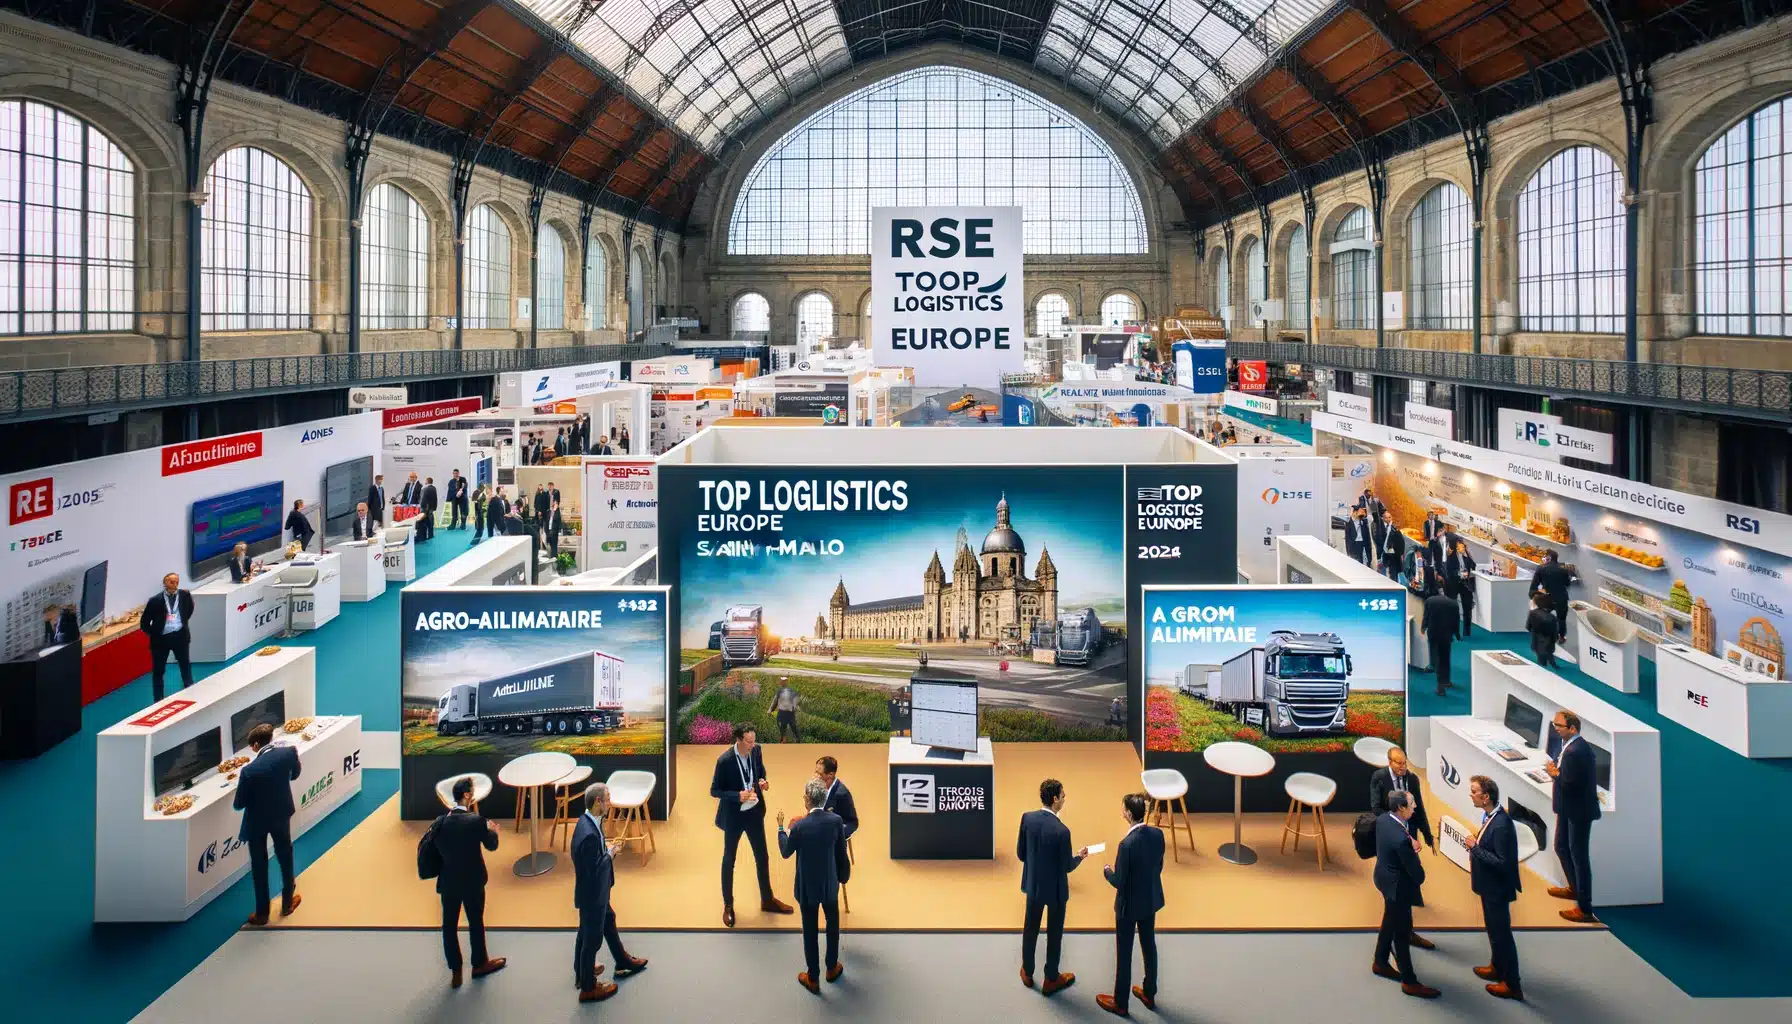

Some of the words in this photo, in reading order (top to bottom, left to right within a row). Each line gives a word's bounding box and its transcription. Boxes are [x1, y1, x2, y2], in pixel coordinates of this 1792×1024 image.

[891, 218, 994, 258] RSE
[895, 271, 979, 292] TOOP
[894, 295, 1003, 312] LOGISTICS
[892, 327, 1010, 350] EUROPE
[16, 486, 48, 517] RE
[698, 480, 750, 511] TOP
[759, 480, 909, 511] LOGLISTICS
[1161, 484, 1203, 501] TOP
[1137, 503, 1204, 517] LOGSTICS
[697, 514, 784, 532] EUROPE
[1138, 545, 1181, 559] 2024
[415, 610, 602, 631] AGRO-AILIMATAIRE
[1170, 605, 1235, 624] GROM
[343, 749, 361, 777] RE
